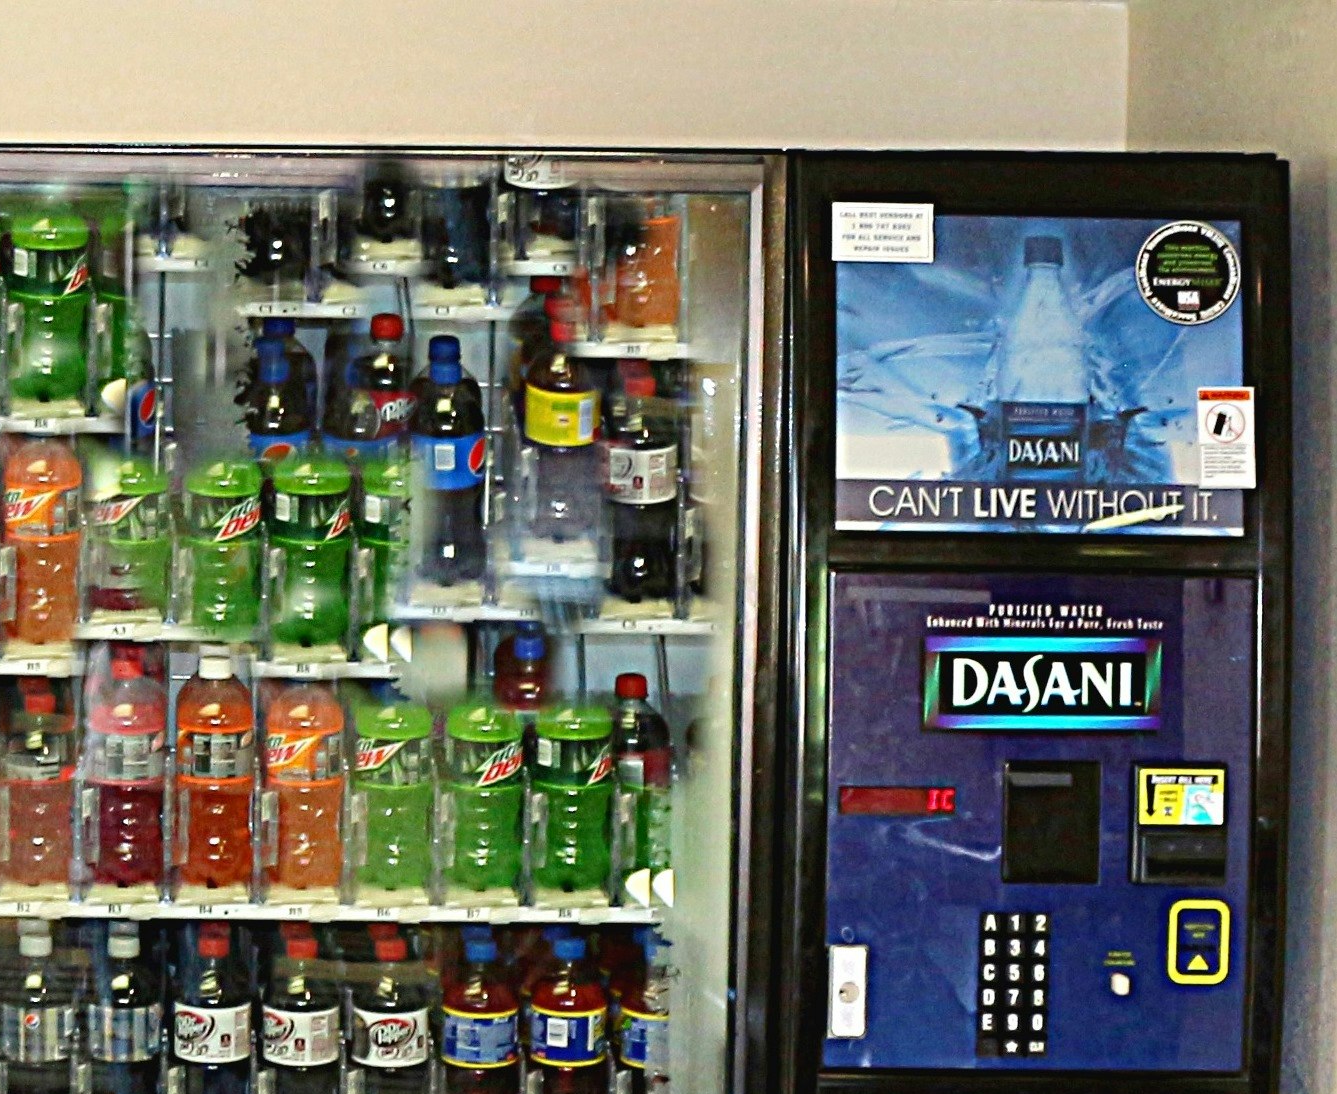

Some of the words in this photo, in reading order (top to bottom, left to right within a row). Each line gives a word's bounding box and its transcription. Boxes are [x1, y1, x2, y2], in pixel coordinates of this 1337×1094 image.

[1008, 439, 1081, 464] DASANI
[869, 486, 963, 517] CAN'T
[974, 487, 1037, 518] LIVE
[1047, 489, 1181, 520] WITHOUT
[1192, 492, 1218, 521] IT.
[989, 604, 1053, 617] PURIFIED
[1060, 605, 1104, 617] WATER
[926, 616, 973, 629] Enhanced
[976, 617, 1000, 629] With
[1003, 617, 1046, 630] Minerals
[1048, 618, 1066, 630] For
[1077, 618, 1104, 631] Pure,
[1107, 618, 1135, 630] Fresh
[1137, 618, 1164, 630] Taste
[952, 654, 1133, 714] DASANI
[984, 914, 997, 931] A
[1010, 914, 1020, 931] 1
[1035, 915, 1047, 931] 2
[984, 939, 996, 956] B
[1009, 939, 1020, 956] 3
[1034, 940, 1045, 956] 4
[983, 964, 995, 981] C
[1008, 964, 1020, 981] 5
[1033, 964, 1044, 981] 6
[982, 989, 995, 1005] D
[1007, 989, 1019, 1005] 7
[1033, 989, 1044, 1006] 8
[981, 1013, 993, 1030] E
[1007, 1013, 1018, 1030] 9
[1032, 1014, 1043, 1030] 0
